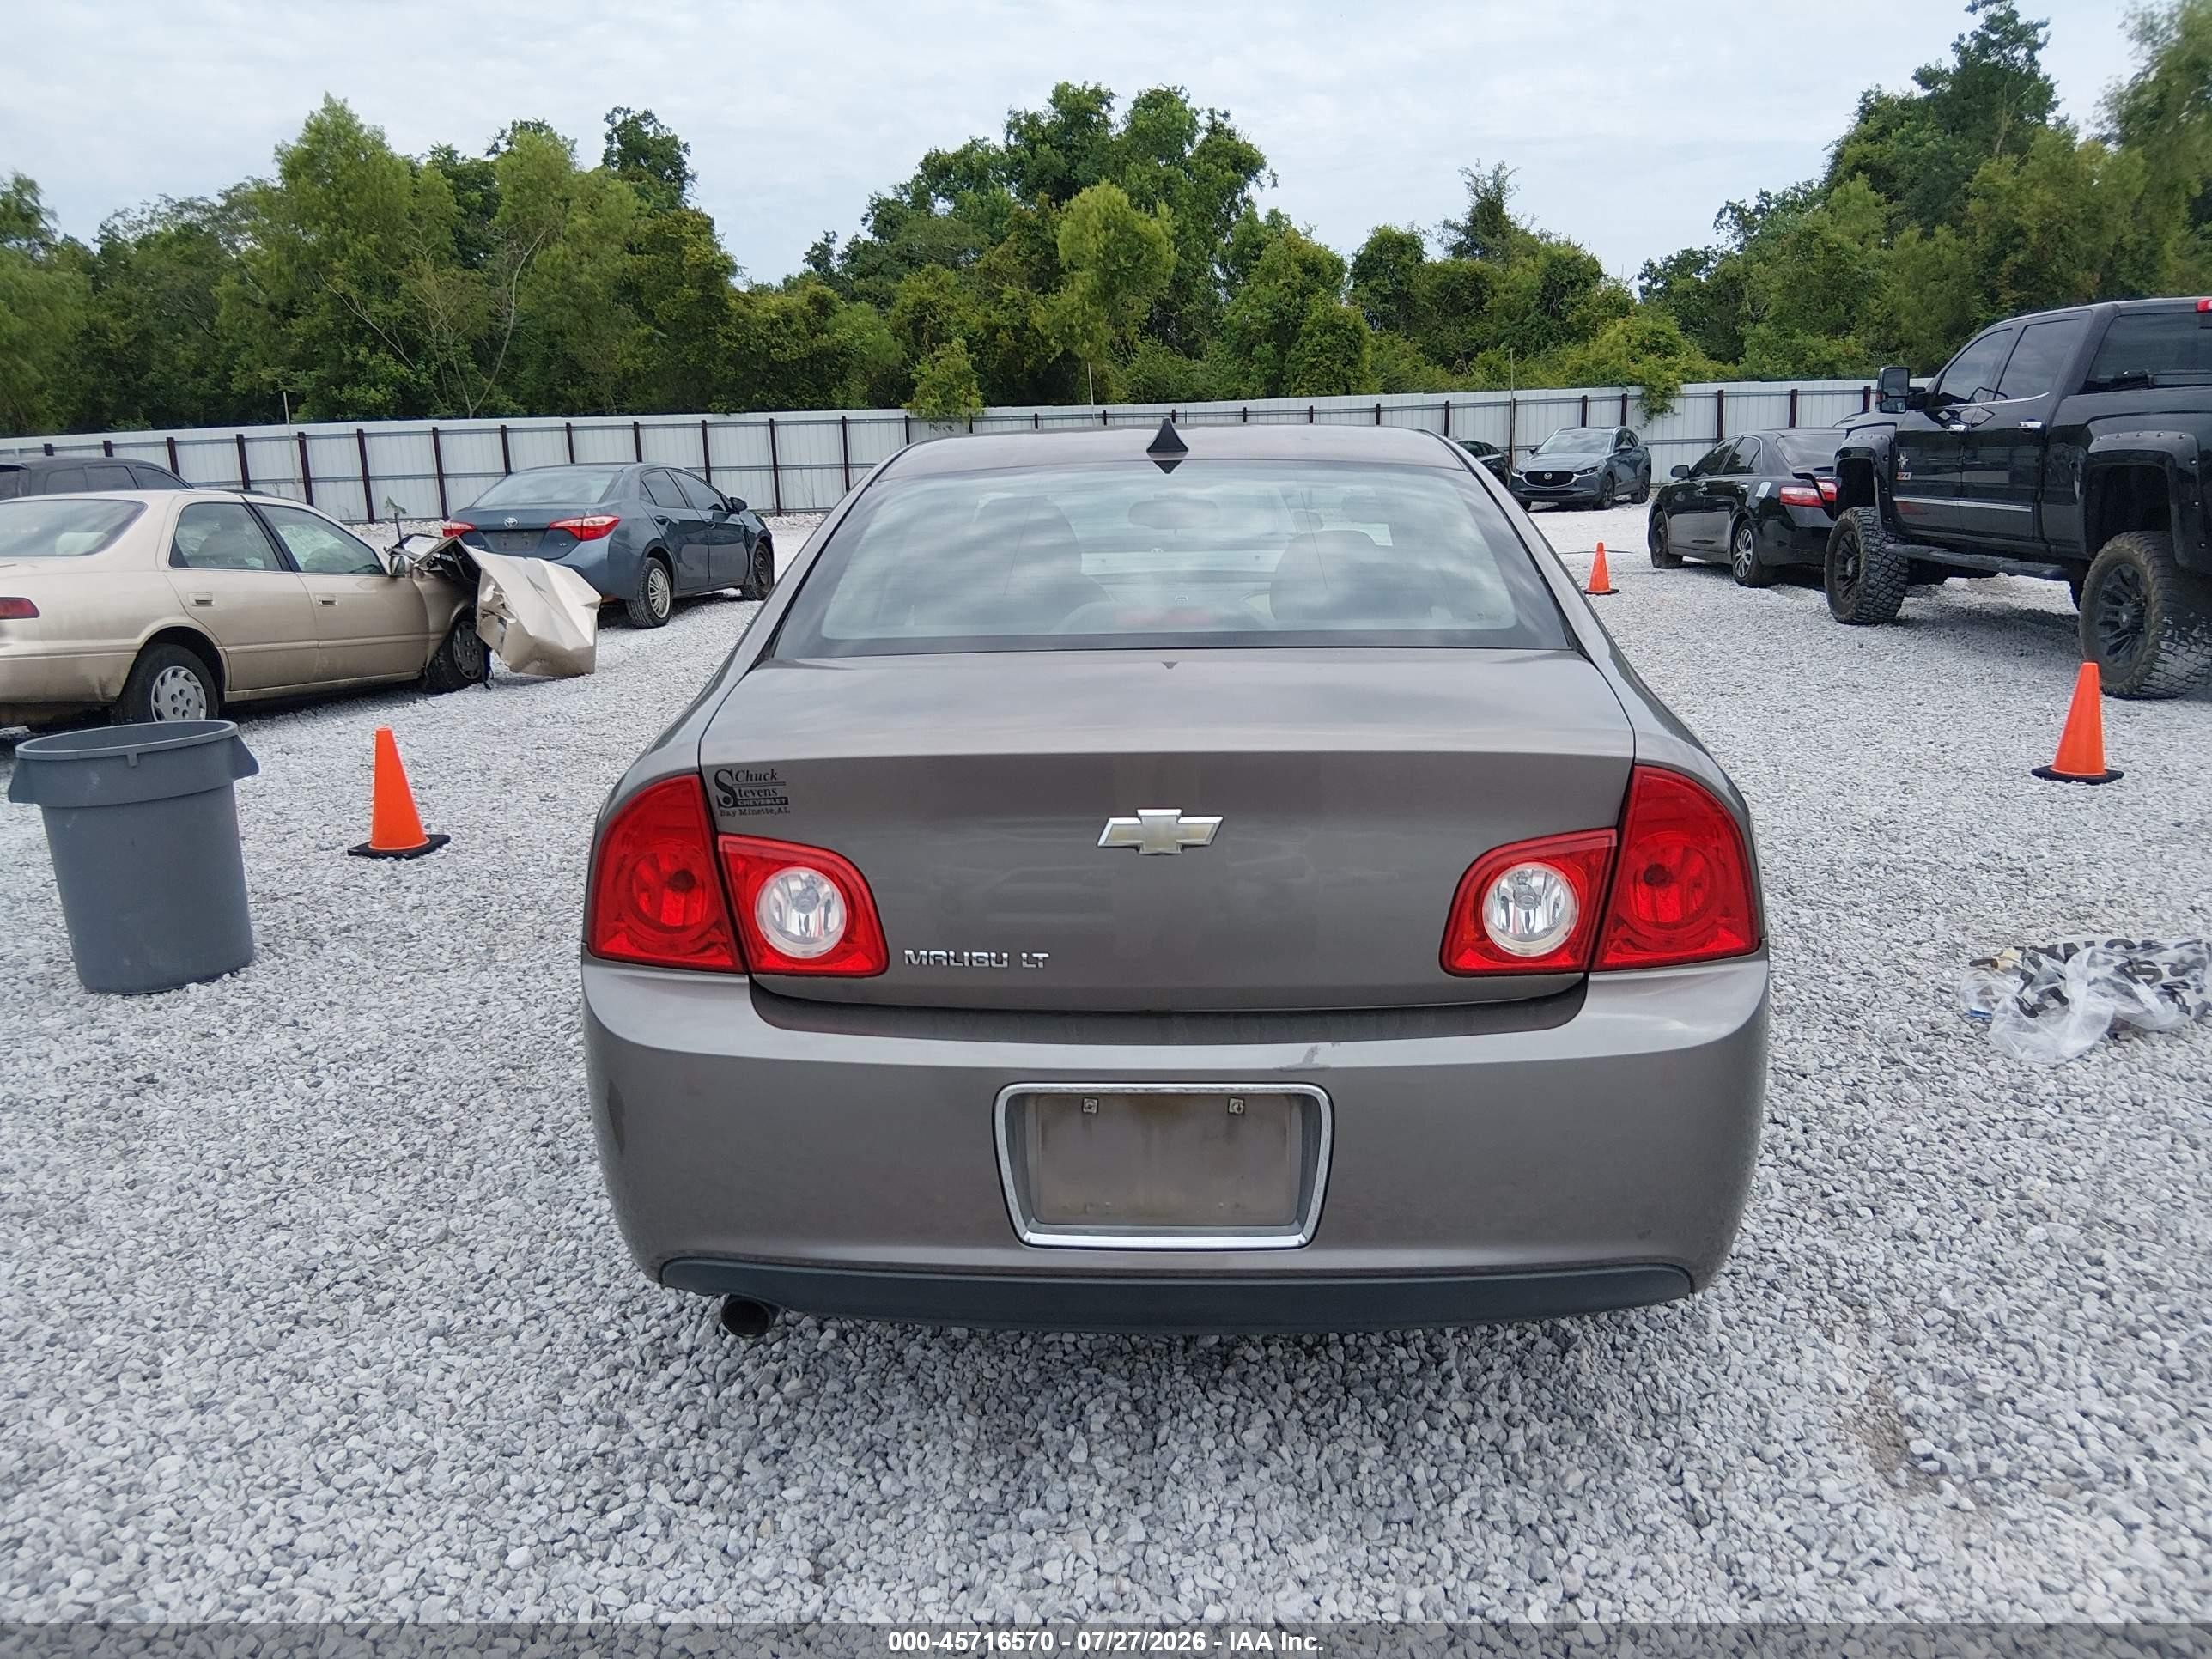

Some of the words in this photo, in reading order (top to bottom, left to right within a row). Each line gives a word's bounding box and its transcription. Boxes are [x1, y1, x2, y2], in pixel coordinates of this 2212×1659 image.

[735, 769, 777, 782] Chuck
[904, 950, 1008, 968] MALIBU
[1021, 952, 1049, 968] LT
